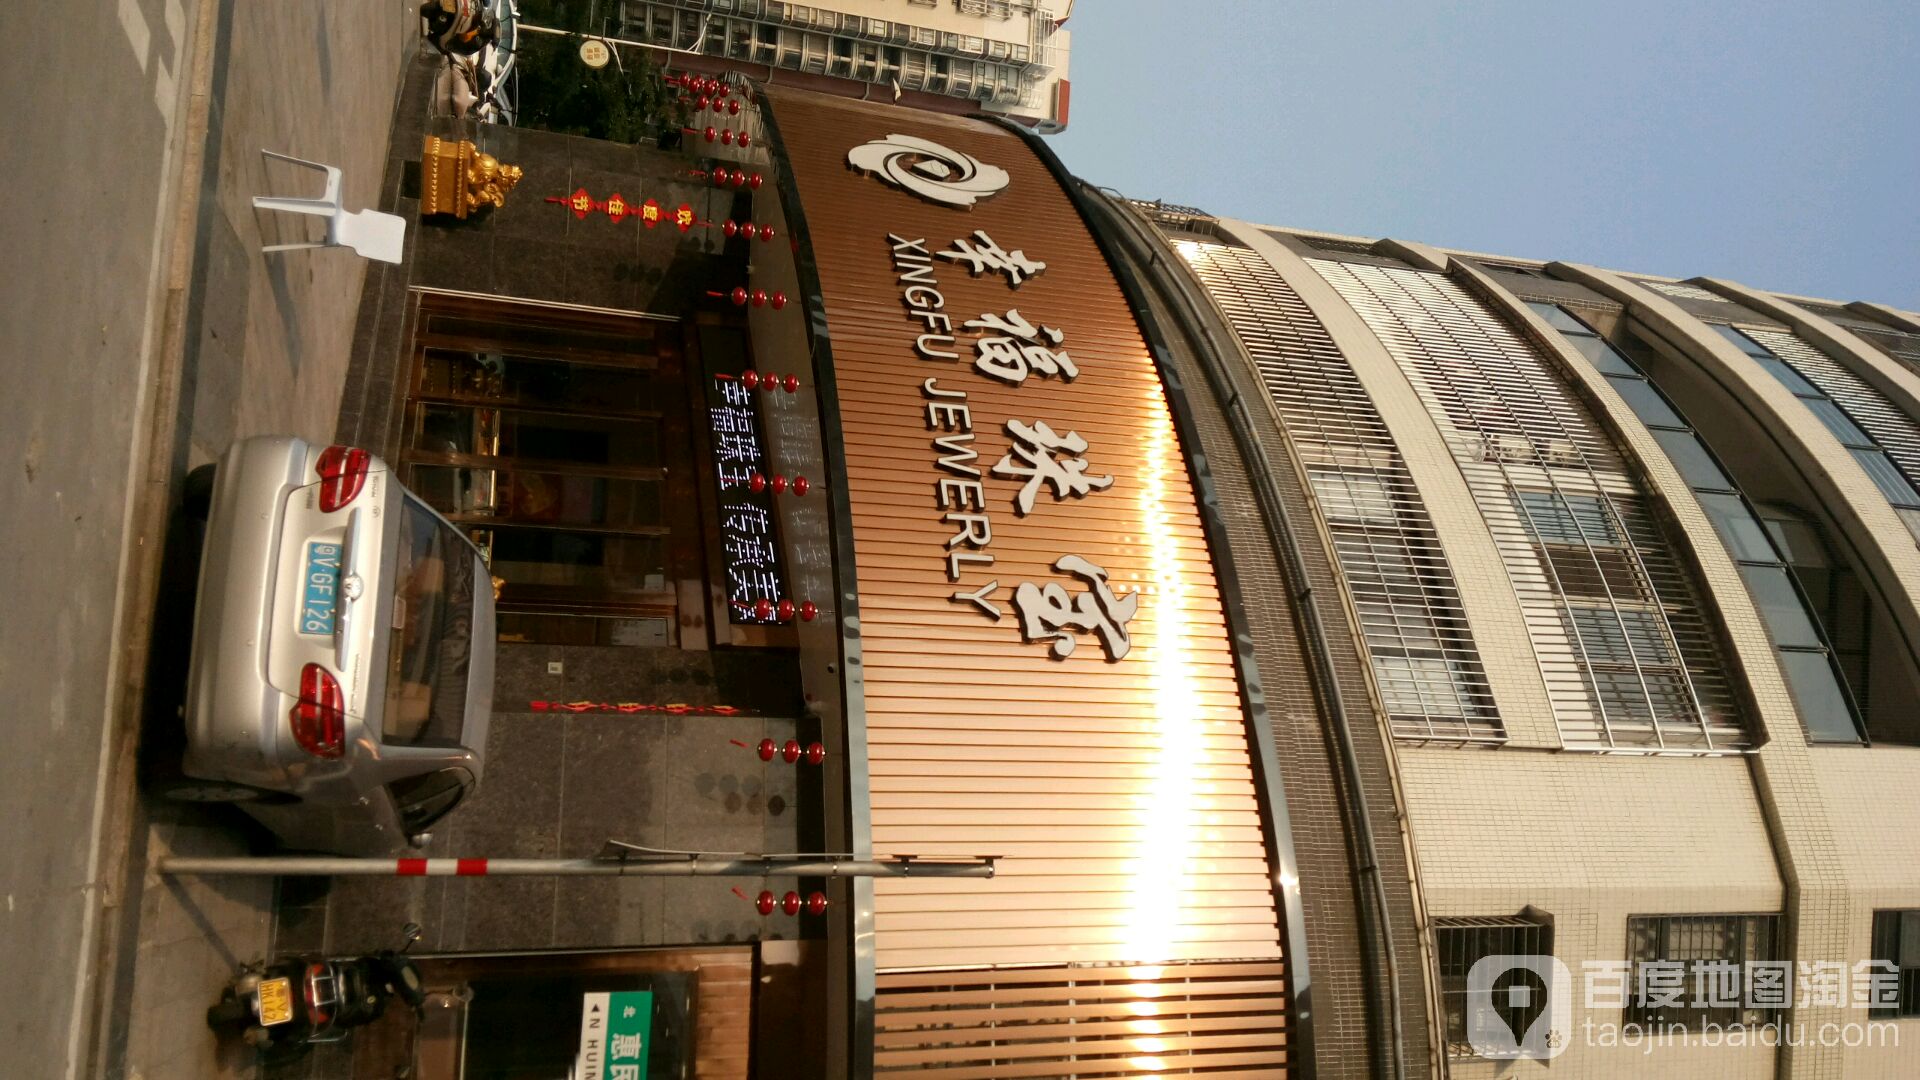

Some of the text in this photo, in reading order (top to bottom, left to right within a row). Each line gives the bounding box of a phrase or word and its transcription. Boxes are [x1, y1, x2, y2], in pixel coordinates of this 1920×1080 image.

[573, 196, 692, 226] 欢度佳节
[888, 233, 1001, 620] XINGFU JEWERLY
[936, 230, 1138, 662] 幸福珠宝
[589, 1018, 600, 1028] N
